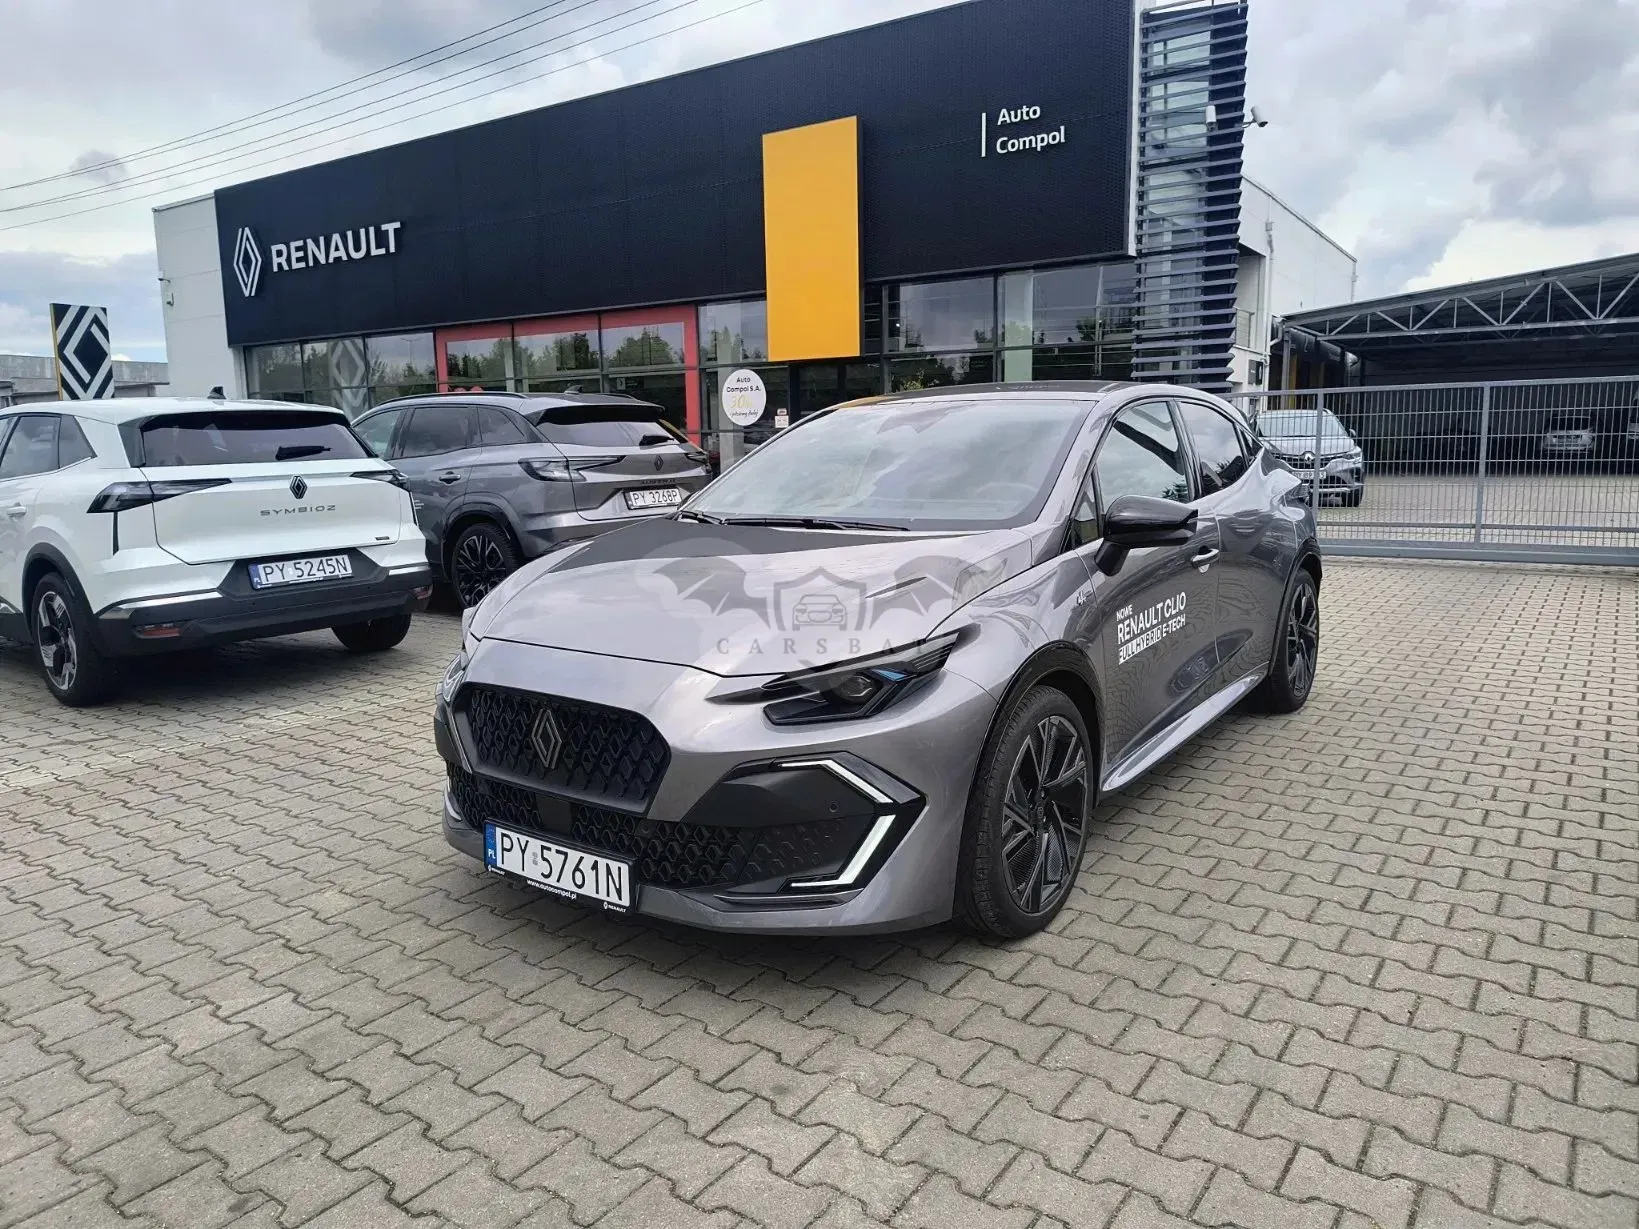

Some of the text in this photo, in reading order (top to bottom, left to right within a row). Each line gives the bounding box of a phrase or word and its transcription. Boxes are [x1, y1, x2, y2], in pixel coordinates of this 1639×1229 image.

[997, 105, 1041, 126] Auto
[996, 125, 1066, 154] Compol
[270, 221, 401, 273] RENAULT
[260, 504, 336, 517] SYMBIOZ
[632, 491, 647, 505] PY
[262, 557, 348, 583] PY 5245N
[1116, 604, 1133, 621] NOWE
[1117, 591, 1187, 645] RENAULT CLIO
[1162, 613, 1186, 638] E-TECH
[488, 849, 496, 859] PL
[500, 832, 623, 901] PY 5761N
